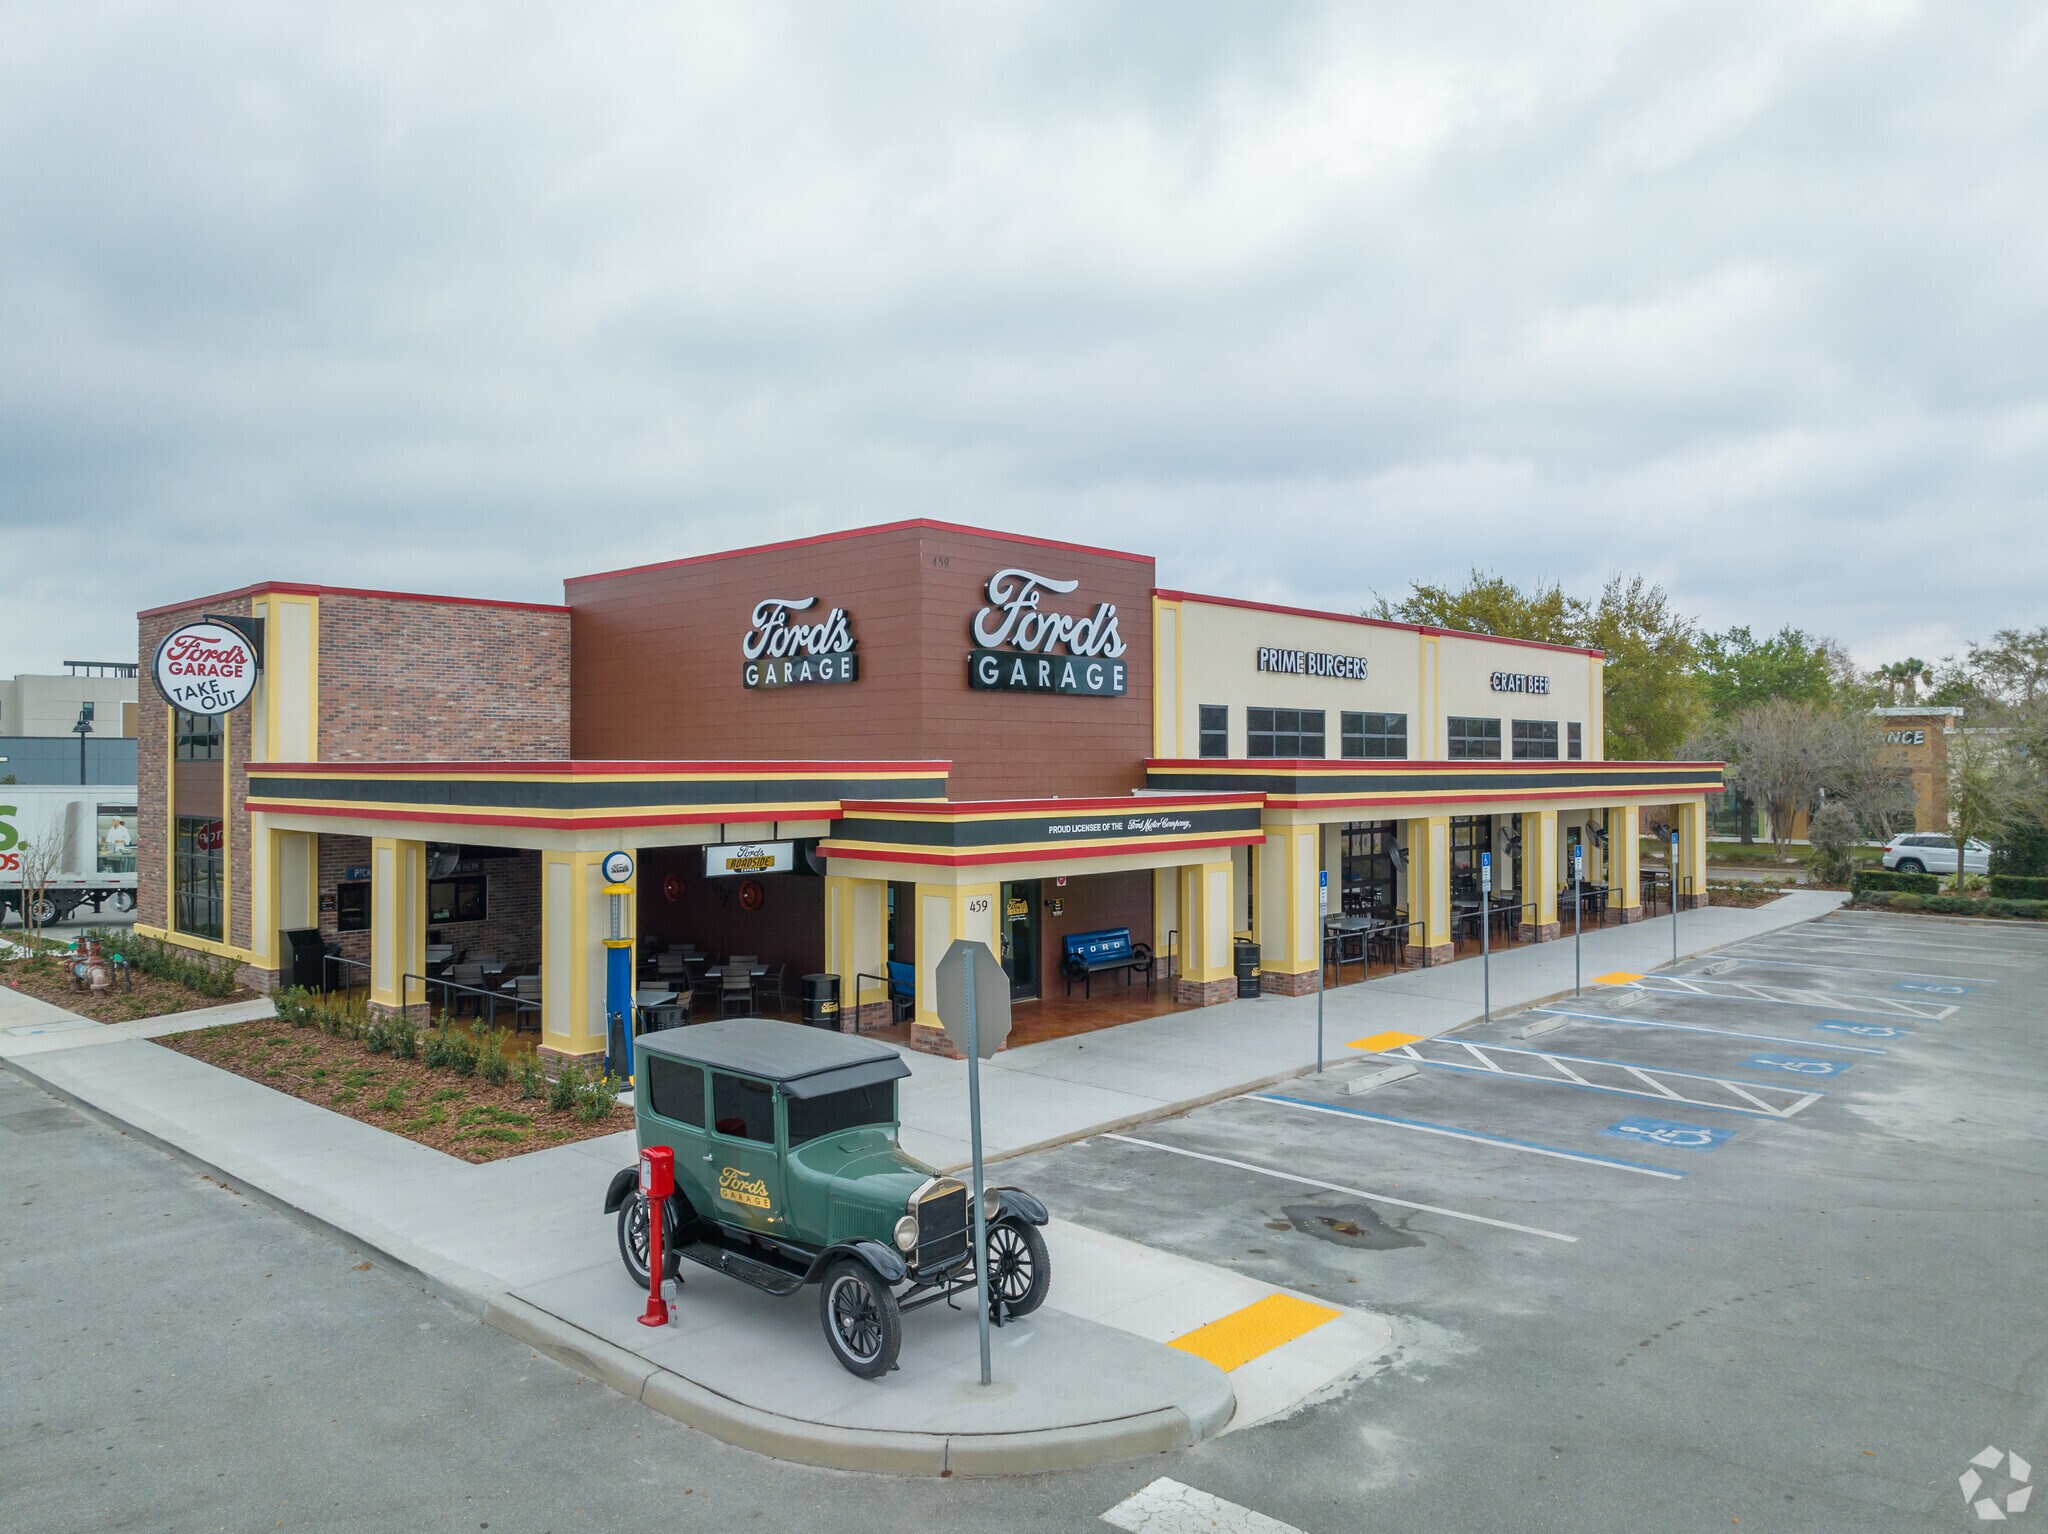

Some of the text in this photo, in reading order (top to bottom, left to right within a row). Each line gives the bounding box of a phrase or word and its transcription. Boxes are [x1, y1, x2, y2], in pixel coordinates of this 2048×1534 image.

[973, 568, 1127, 658] Ford's
[743, 596, 855, 660] Ford's
[167, 634, 249, 664] Ford's
[168, 662, 243, 678] GARAGE
[745, 657, 850, 686] GARAGE
[978, 655, 1124, 691] GARAGE
[1258, 647, 1368, 680] PRIME BURGERS
[173, 679, 220, 702] TAKE
[1490, 671, 1551, 694] CRAFT BEER
[201, 690, 236, 710] OUT
[1048, 825, 1070, 834] PROUD
[1072, 823, 1101, 833] LICENSEE
[1102, 823, 1111, 831] OF
[1111, 822, 1123, 831] THE
[1127, 818, 1143, 830] Ford
[1141, 818, 1161, 832] Motor
[730, 856, 771, 869] ROADSIDE
[969, 900, 988, 913] 459
[1077, 941, 1121, 955] FORD
[718, 1166, 769, 1197] Ford's
[721, 1189, 769, 1207] GARAGE
